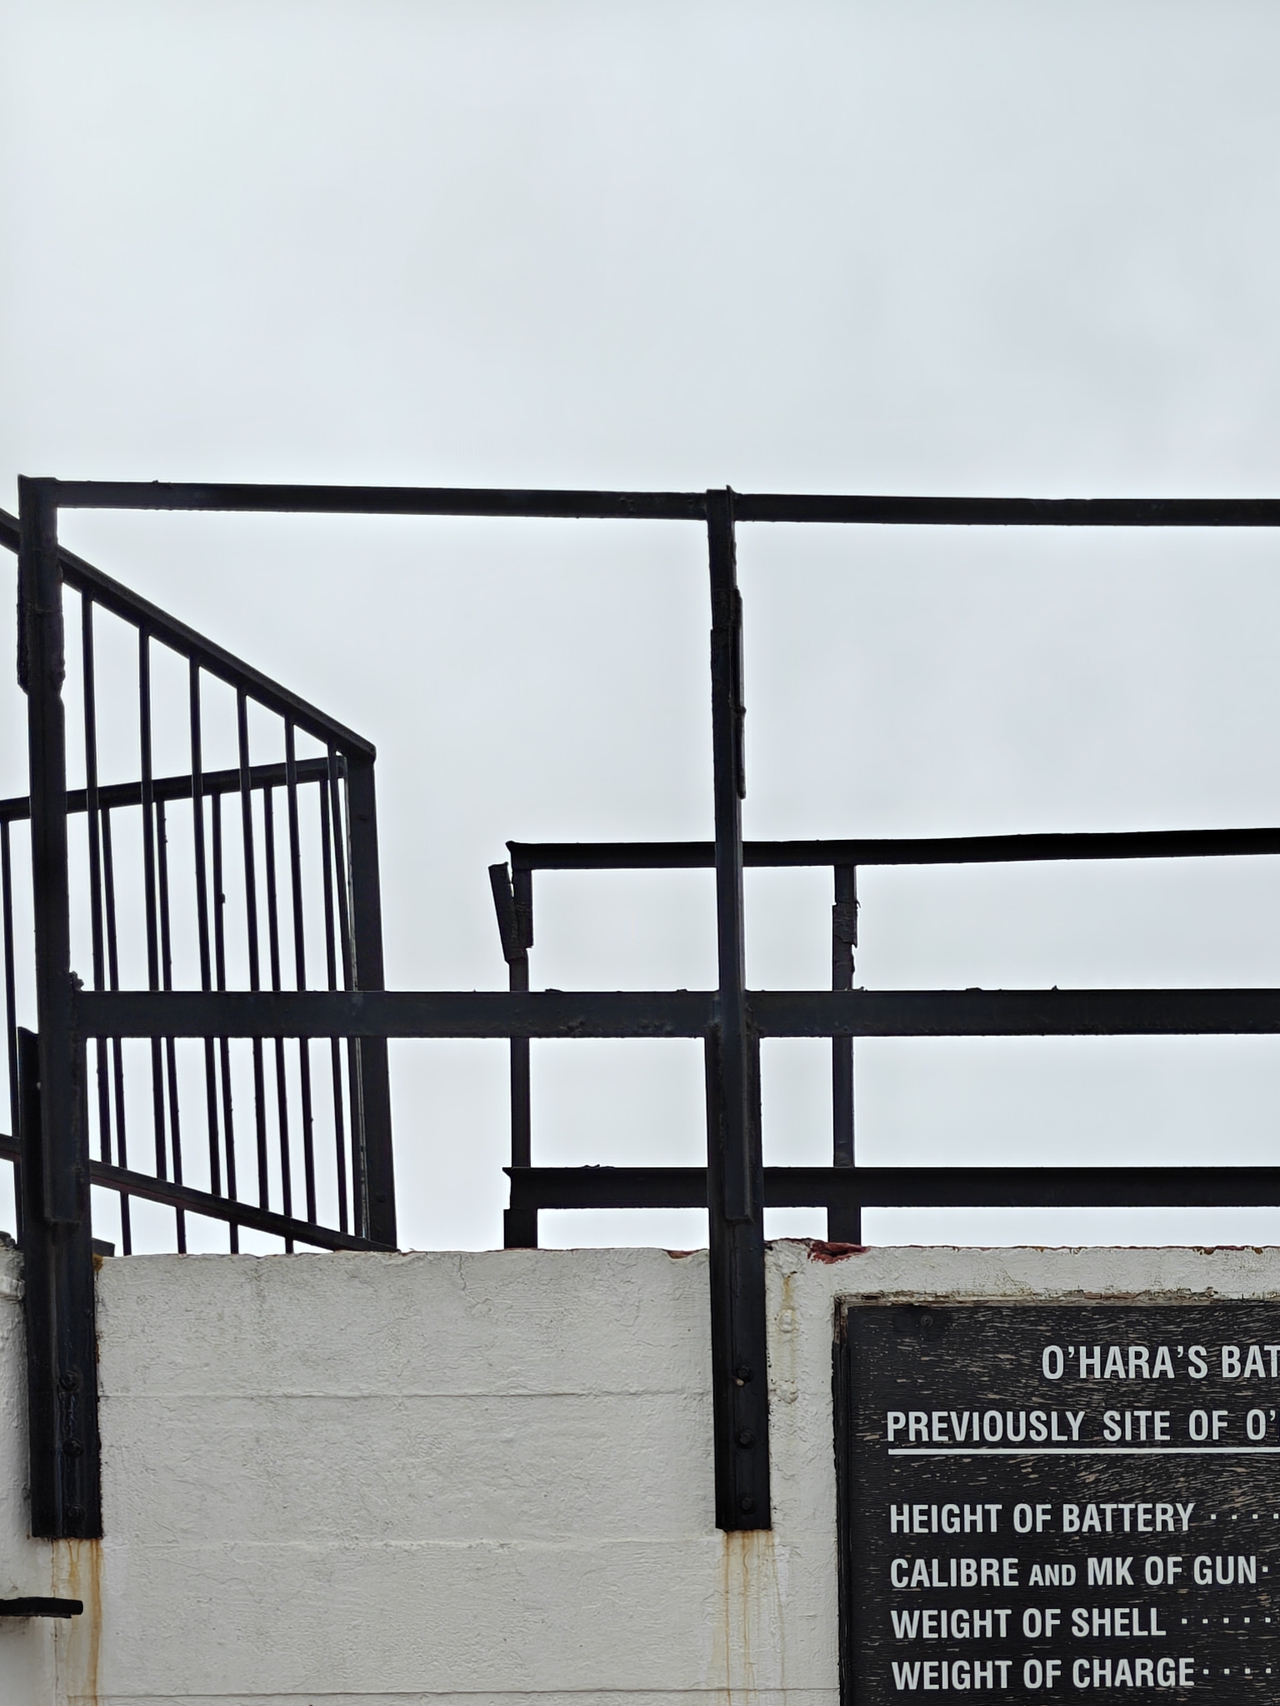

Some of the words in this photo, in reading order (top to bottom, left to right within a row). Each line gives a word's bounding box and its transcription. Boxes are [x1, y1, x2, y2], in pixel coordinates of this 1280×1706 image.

[887, 1410, 1086, 1442] PREVIOUSLY
[1103, 1410, 1171, 1442] SITE
[1188, 1409, 1229, 1441] OF
[890, 1503, 1003, 1534] HEIGHT
[1013, 1503, 1052, 1533] OF
[1062, 1502, 1196, 1533] BATTERY
[890, 1557, 1019, 1588] CALIBRE
[1028, 1564, 1076, 1586] AND
[1087, 1556, 1134, 1586] MK
[1145, 1555, 1183, 1586] OF
[1193, 1555, 1257, 1585] GUN
[890, 1609, 1012, 1639] WEIGHT
[1022, 1608, 1061, 1638] OF
[1071, 1607, 1167, 1637] SHELL
[891, 1660, 1013, 1690] WEIGHT
[1023, 1659, 1062, 1689] OF
[1072, 1657, 1195, 1688] CHARGE
